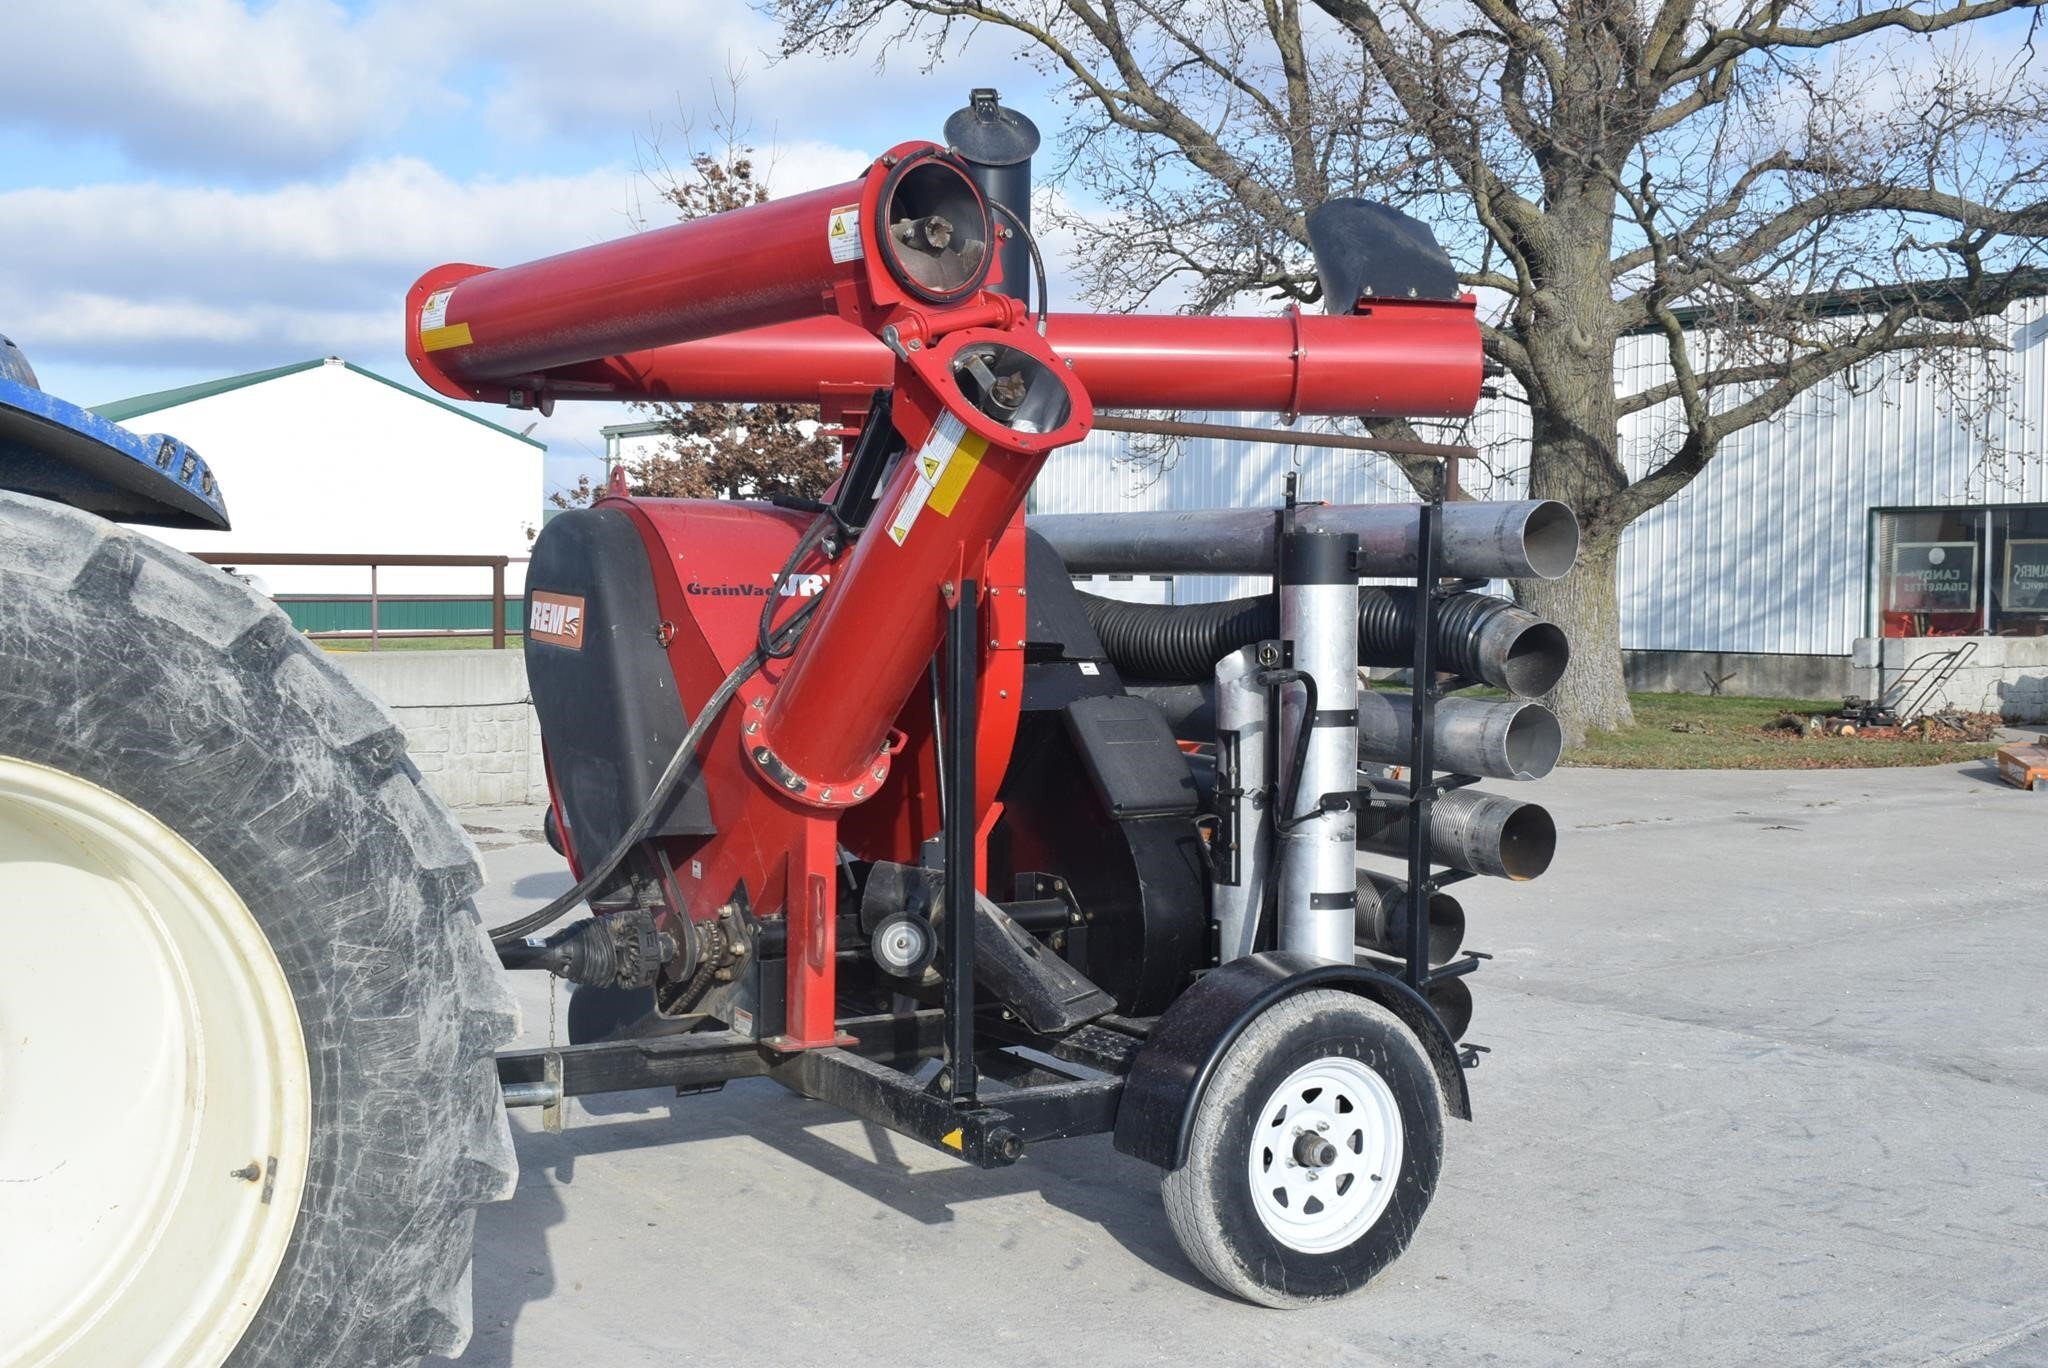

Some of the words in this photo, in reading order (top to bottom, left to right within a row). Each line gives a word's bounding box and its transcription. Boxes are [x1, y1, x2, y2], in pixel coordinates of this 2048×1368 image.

[772, 573, 830, 597] VR
[530, 600, 565, 635] REM
[168, 733, 430, 1207] ALLIANCE
